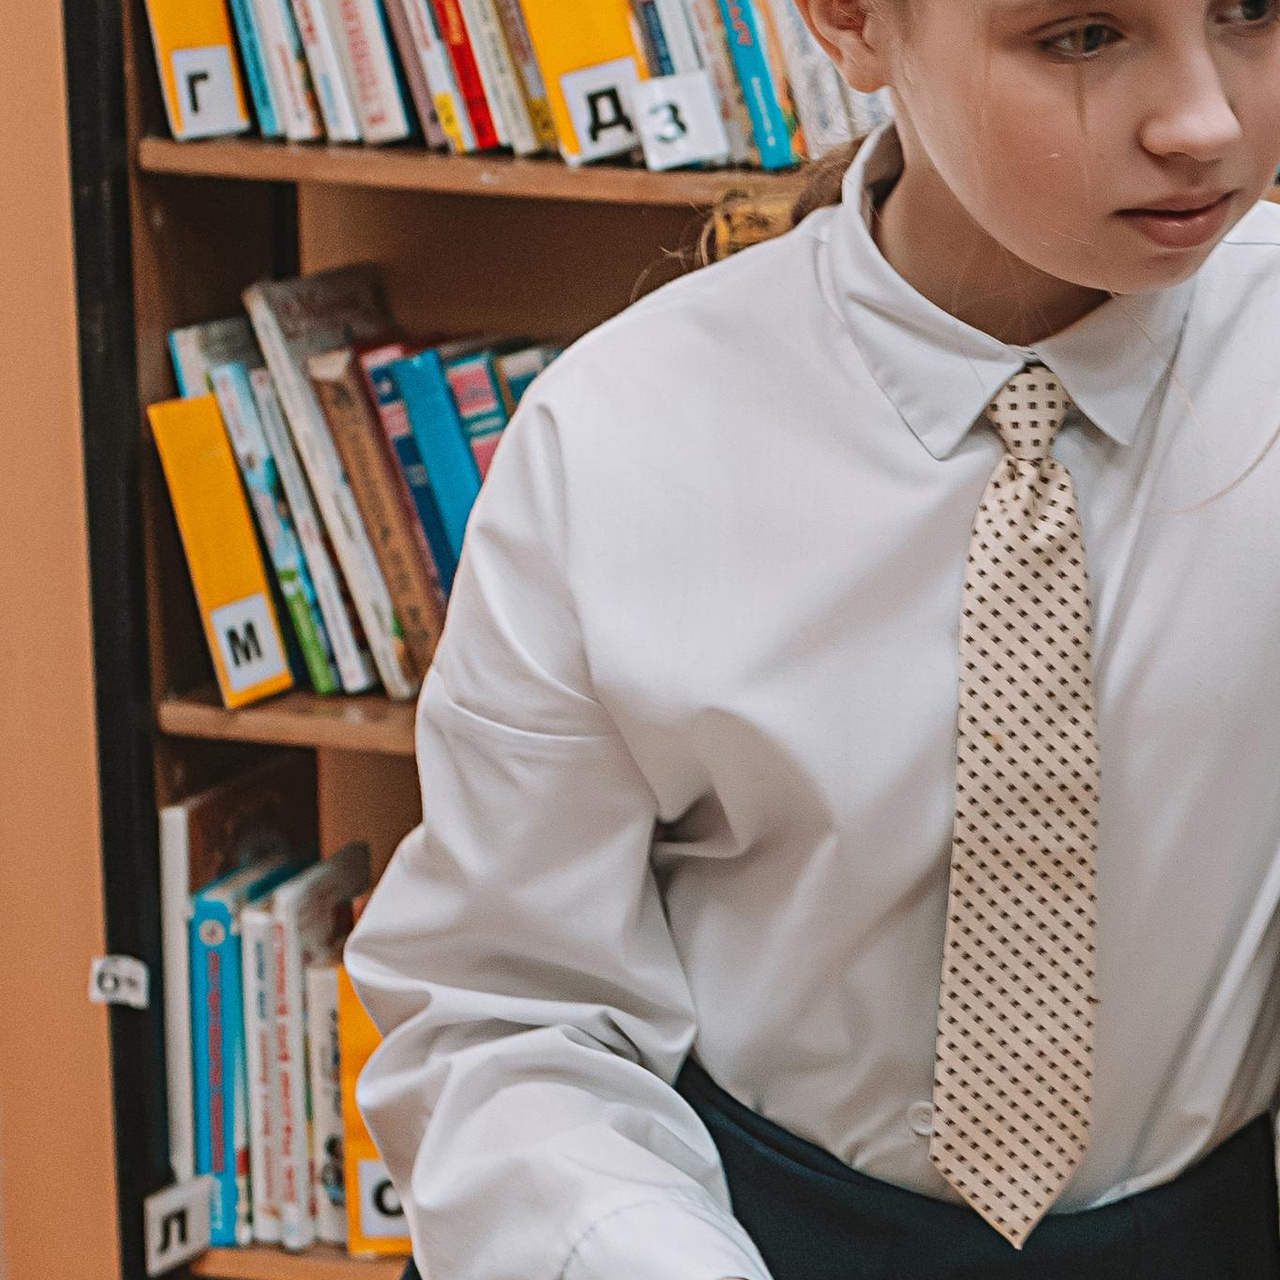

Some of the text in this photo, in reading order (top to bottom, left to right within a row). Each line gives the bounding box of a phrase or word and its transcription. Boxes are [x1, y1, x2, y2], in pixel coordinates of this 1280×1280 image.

[187, 69, 209, 116] Г
[588, 84, 633, 141] Д
[225, 620, 261, 667] М
[158, 1210, 188, 1255] Л
